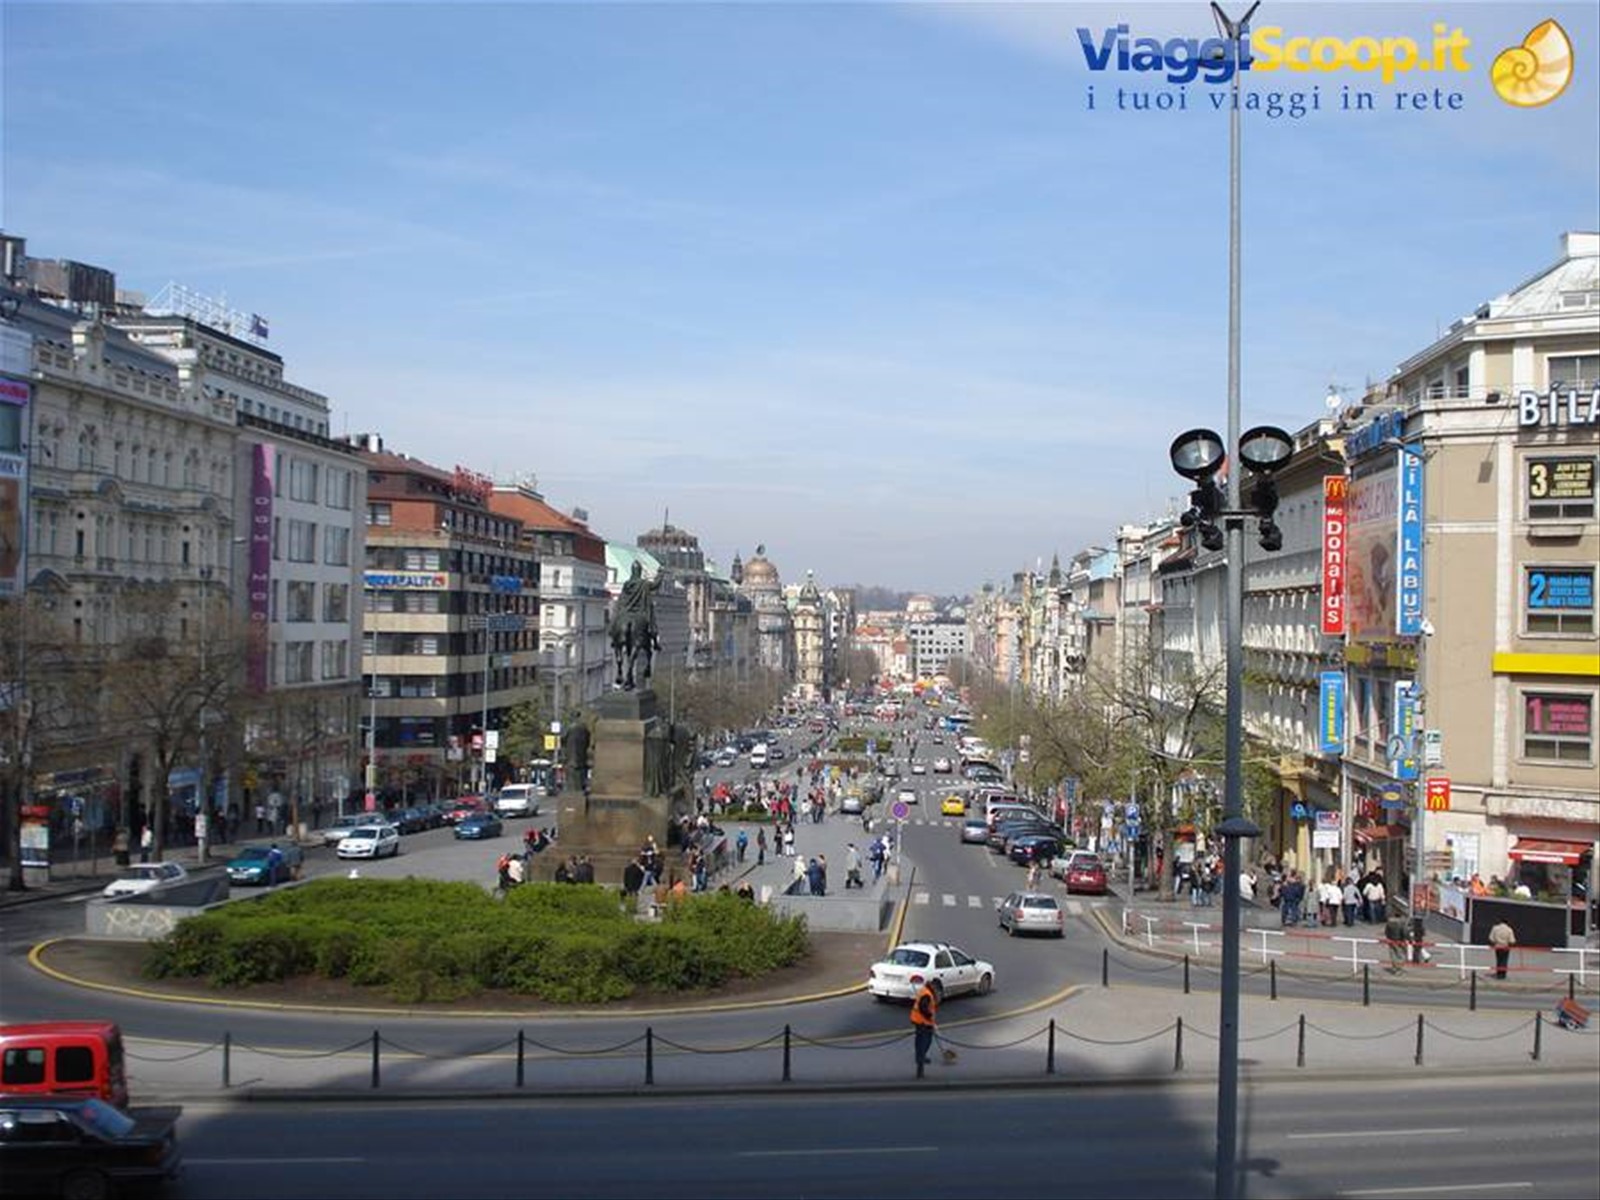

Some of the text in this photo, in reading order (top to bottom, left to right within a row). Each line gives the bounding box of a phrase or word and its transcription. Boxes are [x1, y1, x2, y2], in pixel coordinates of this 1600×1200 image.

[1531, 464, 1547, 497] 3
[1530, 574, 1545, 606] 2
[1529, 698, 1541, 731] 1
